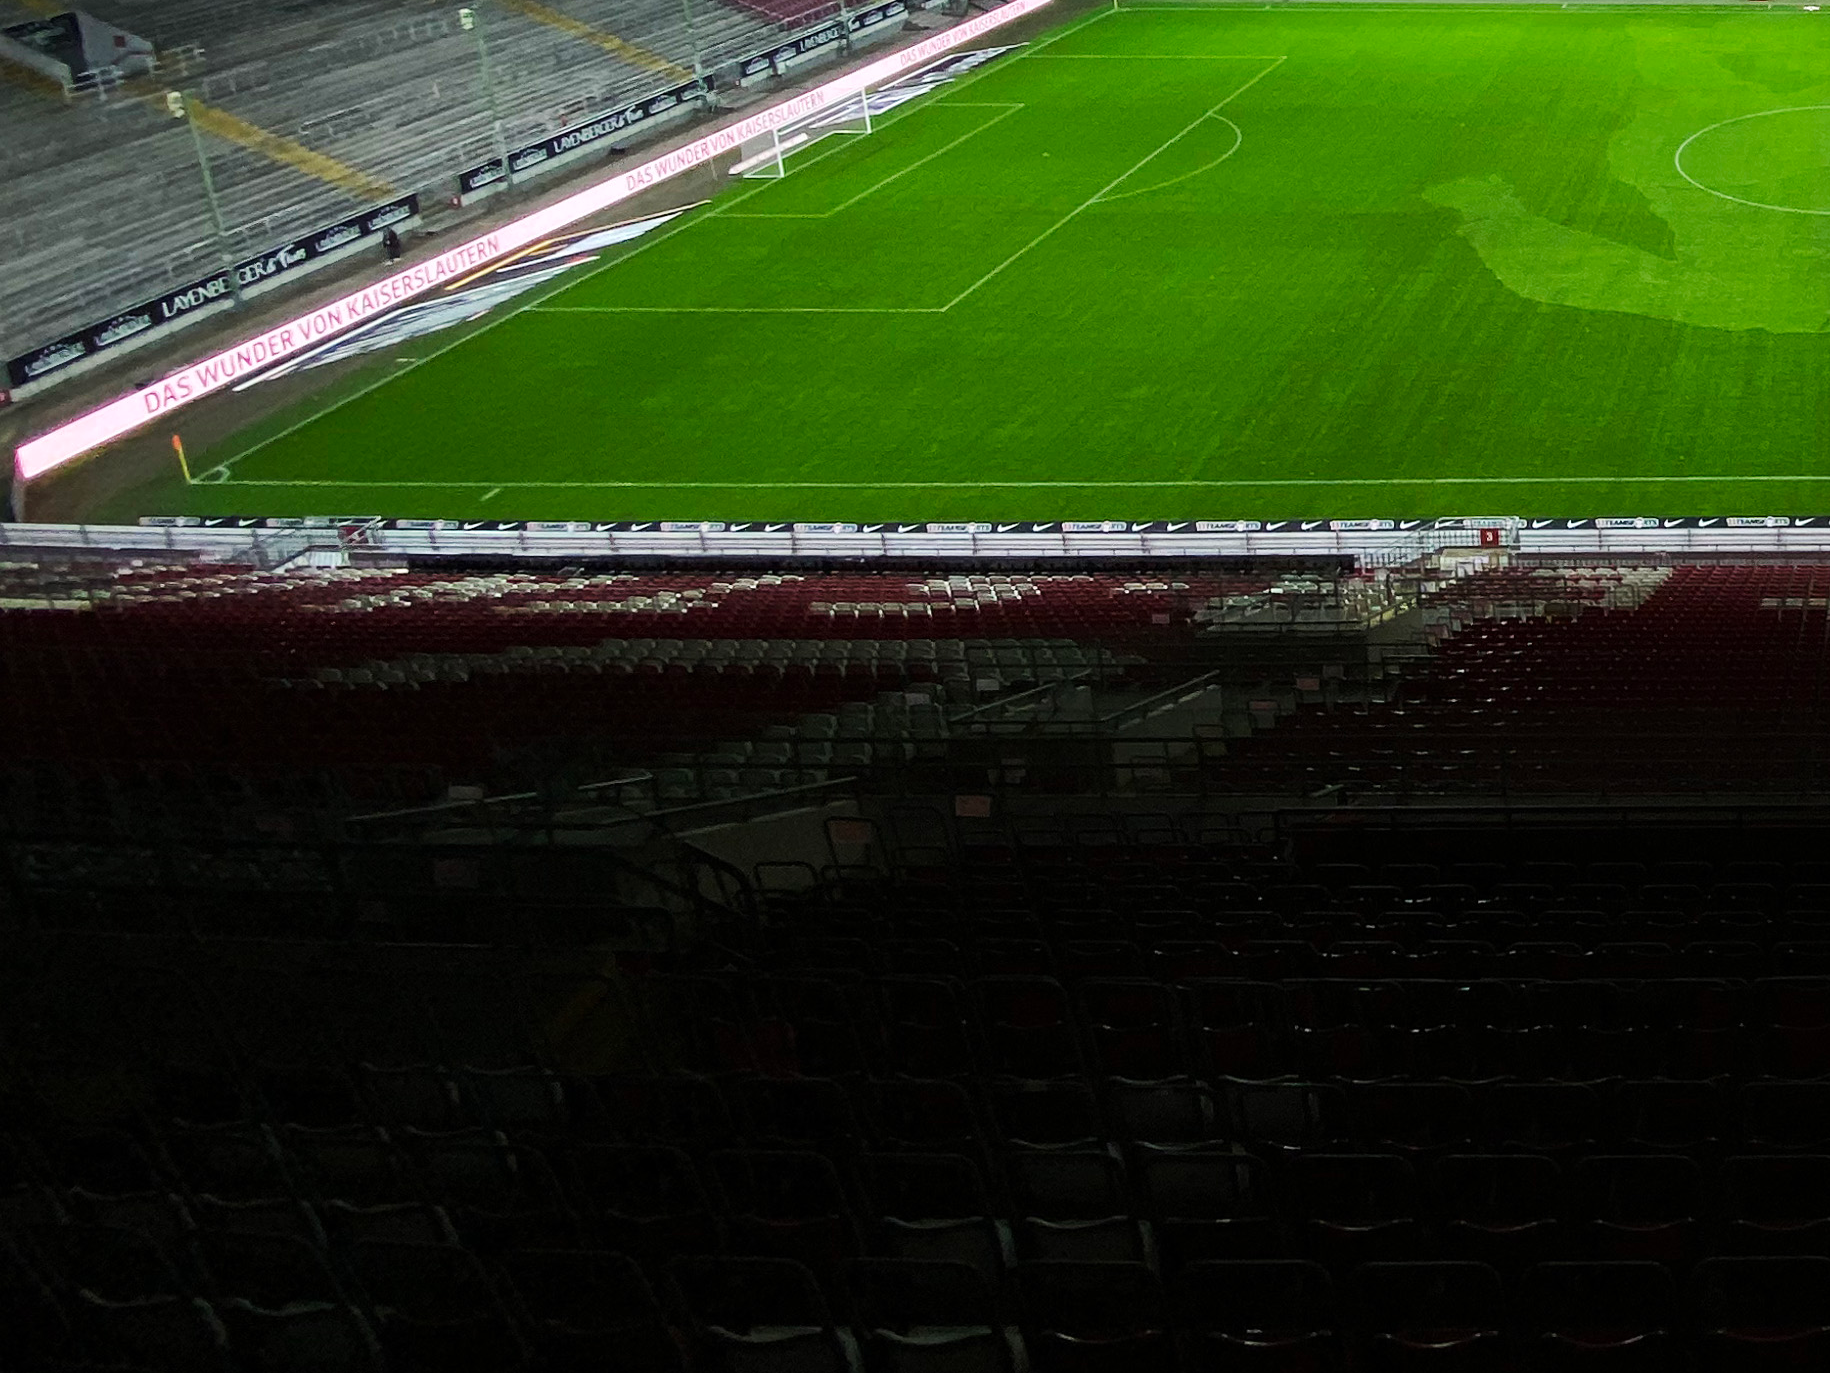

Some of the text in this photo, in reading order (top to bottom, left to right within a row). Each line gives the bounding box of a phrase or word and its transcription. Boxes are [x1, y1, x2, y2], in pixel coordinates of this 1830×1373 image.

[627, 91, 824, 191] DAS WUNDER VON KAISERSLAUTERN
[144, 375, 193, 414] DAS
[195, 329, 296, 388] WUNDER
[297, 306, 343, 340] VON
[347, 235, 500, 320] KAISERSLAUTERN
